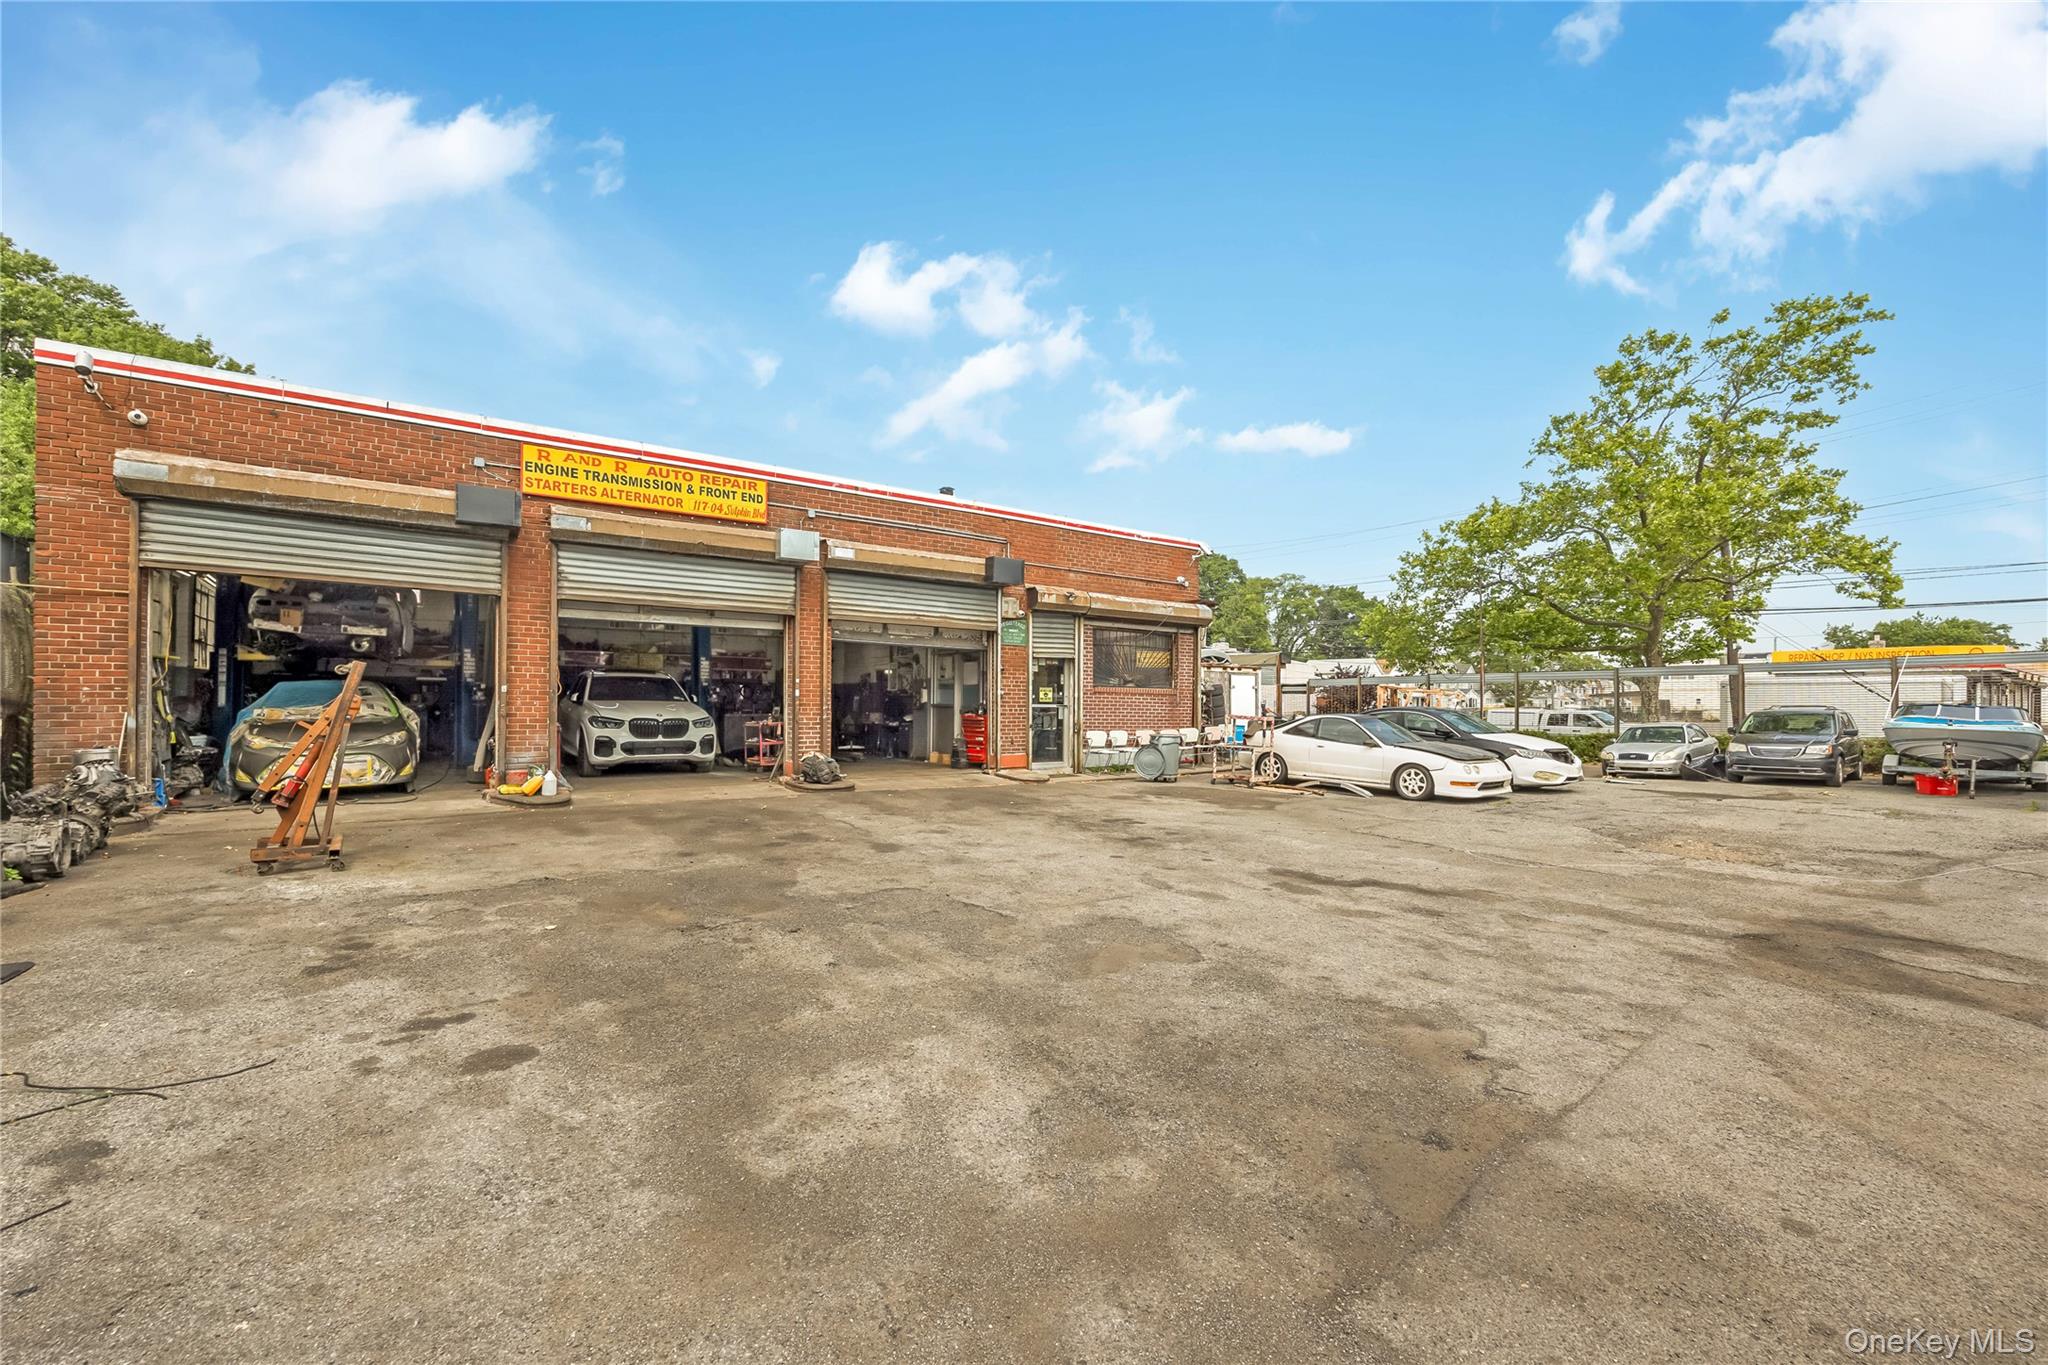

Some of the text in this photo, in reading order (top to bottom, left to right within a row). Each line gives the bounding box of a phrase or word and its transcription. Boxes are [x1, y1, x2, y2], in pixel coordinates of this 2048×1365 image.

[524, 460, 764, 505] ENGINE TRANSMISSION & FRONT END
[537, 449, 758, 492] R AND R AUTO REPAIR
[525, 476, 598, 497] STARTERS
[600, 487, 684, 509] ALTERNATOR
[1788, 653, 1817, 663] REPAIR
